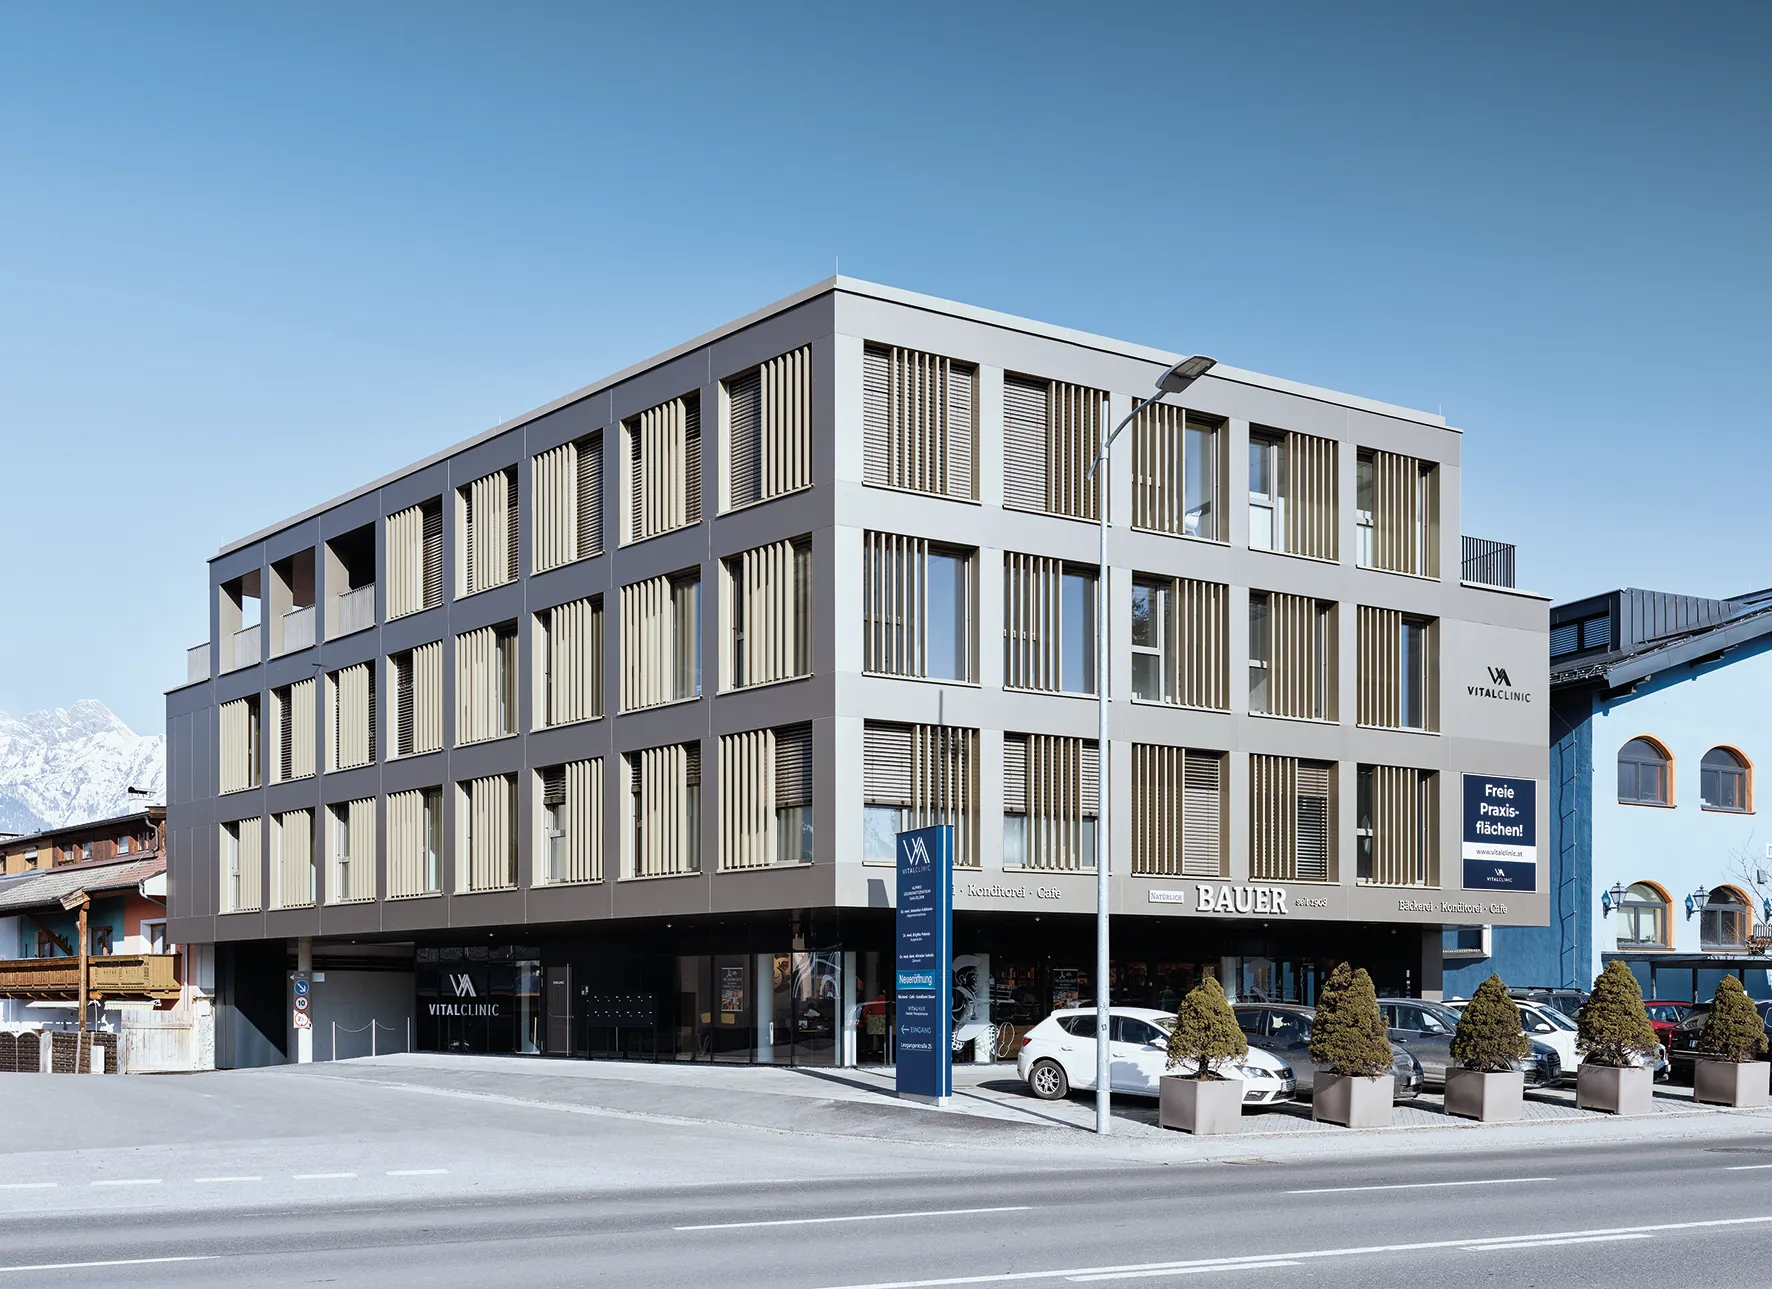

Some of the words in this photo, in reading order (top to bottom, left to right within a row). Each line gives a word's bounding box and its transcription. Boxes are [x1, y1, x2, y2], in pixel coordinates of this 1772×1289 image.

[1467, 686, 1531, 703] VITALCLINIC
[1485, 784, 1515, 799] Freie
[1480, 802, 1520, 818] Praxis-
[1475, 820, 1523, 837] flächen!
[1475, 848, 1523, 858] www.vitalclinic.at
[902, 864, 931, 875] VITALCLINIC
[967, 884, 1026, 898] Konditorei
[1036, 886, 1062, 899] Cafe
[1195, 884, 1289, 914] BAUER
[1397, 899, 1433, 912] Bäckerei
[1440, 901, 1483, 914] Konditorei
[1489, 903, 1508, 914] Cafe
[899, 973, 933, 986] Neueröffnung
[297, 999, 306, 1007] 10
[428, 1003, 500, 1016] VITALCLINIC
[910, 1026, 932, 1034] EINGANG
